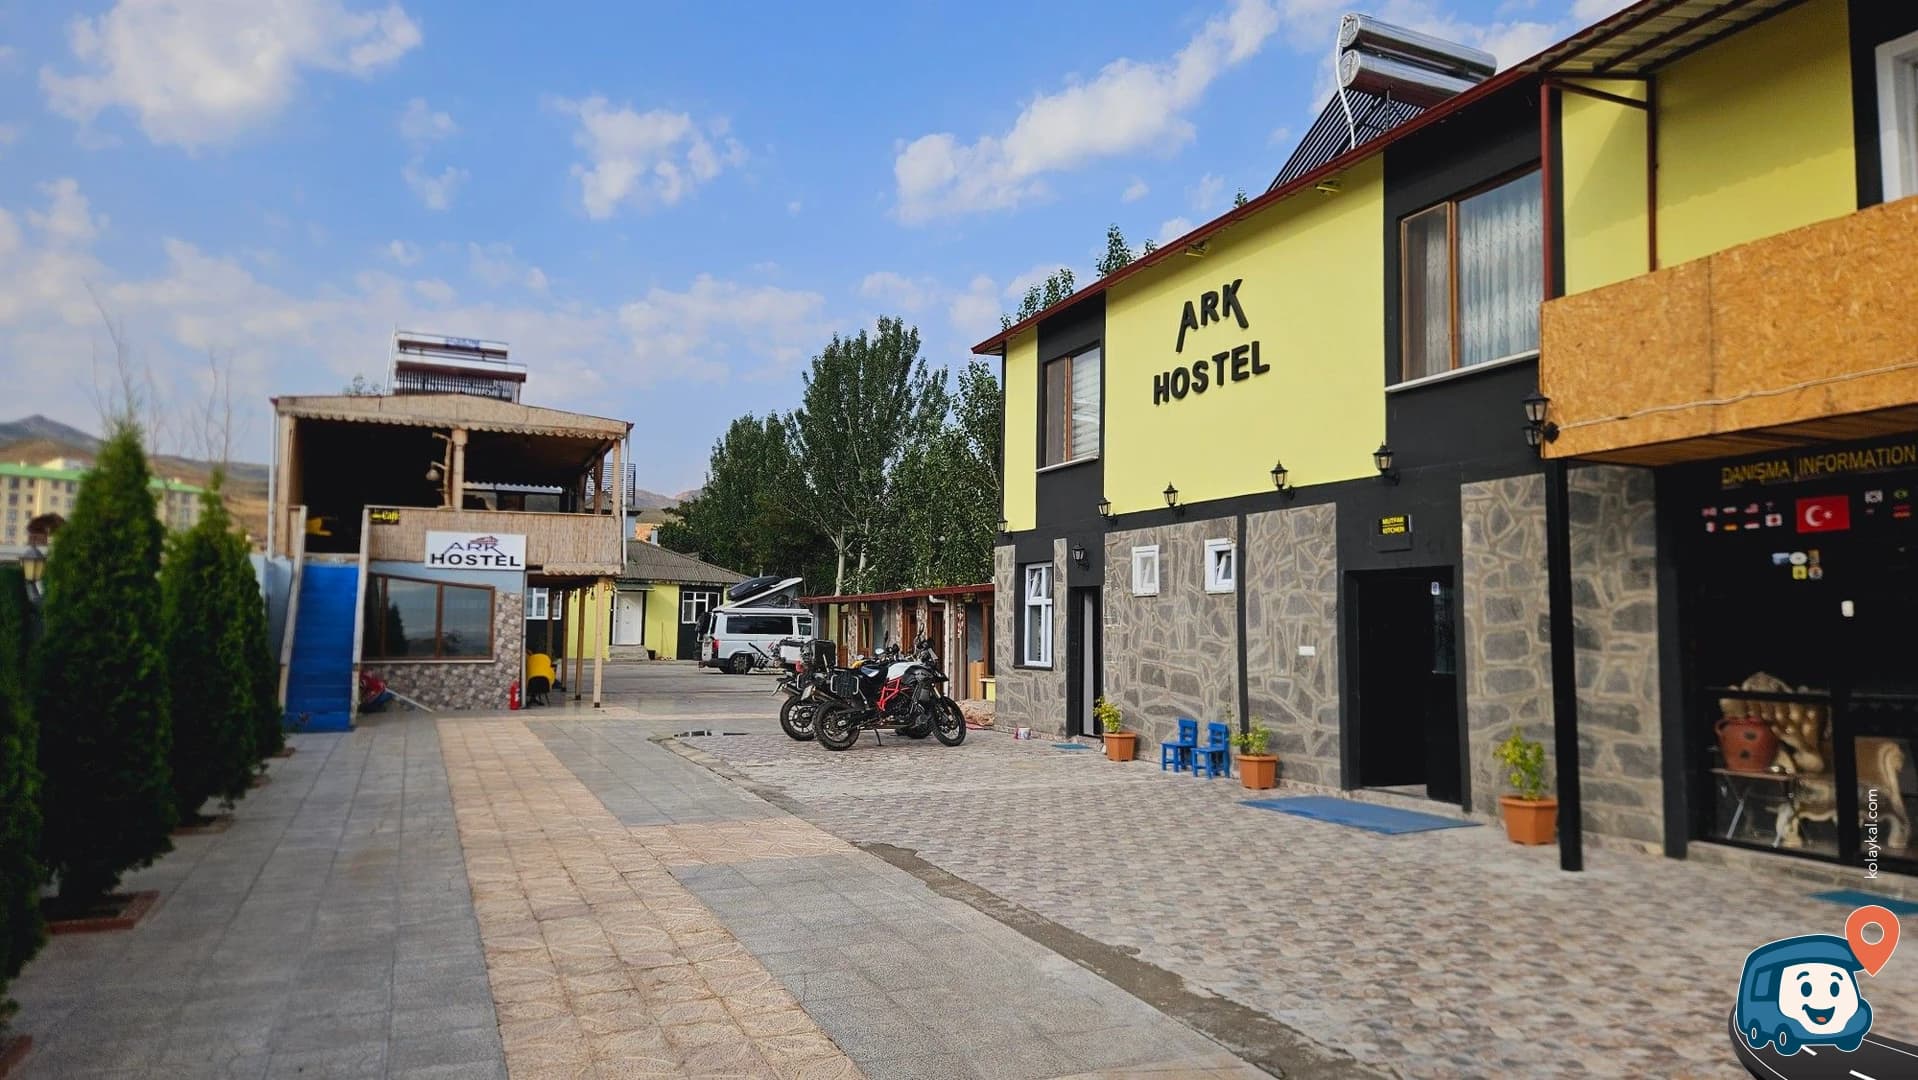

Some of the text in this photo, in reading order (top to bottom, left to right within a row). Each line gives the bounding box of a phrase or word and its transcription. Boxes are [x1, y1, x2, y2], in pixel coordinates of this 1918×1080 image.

[1176, 279, 1249, 353] ARK
[1153, 340, 1270, 406] HOSTEL
[1799, 445, 1916, 475] INFORMATION
[431, 552, 521, 567] HOSTEL
[442, 541, 506, 557] ARK
